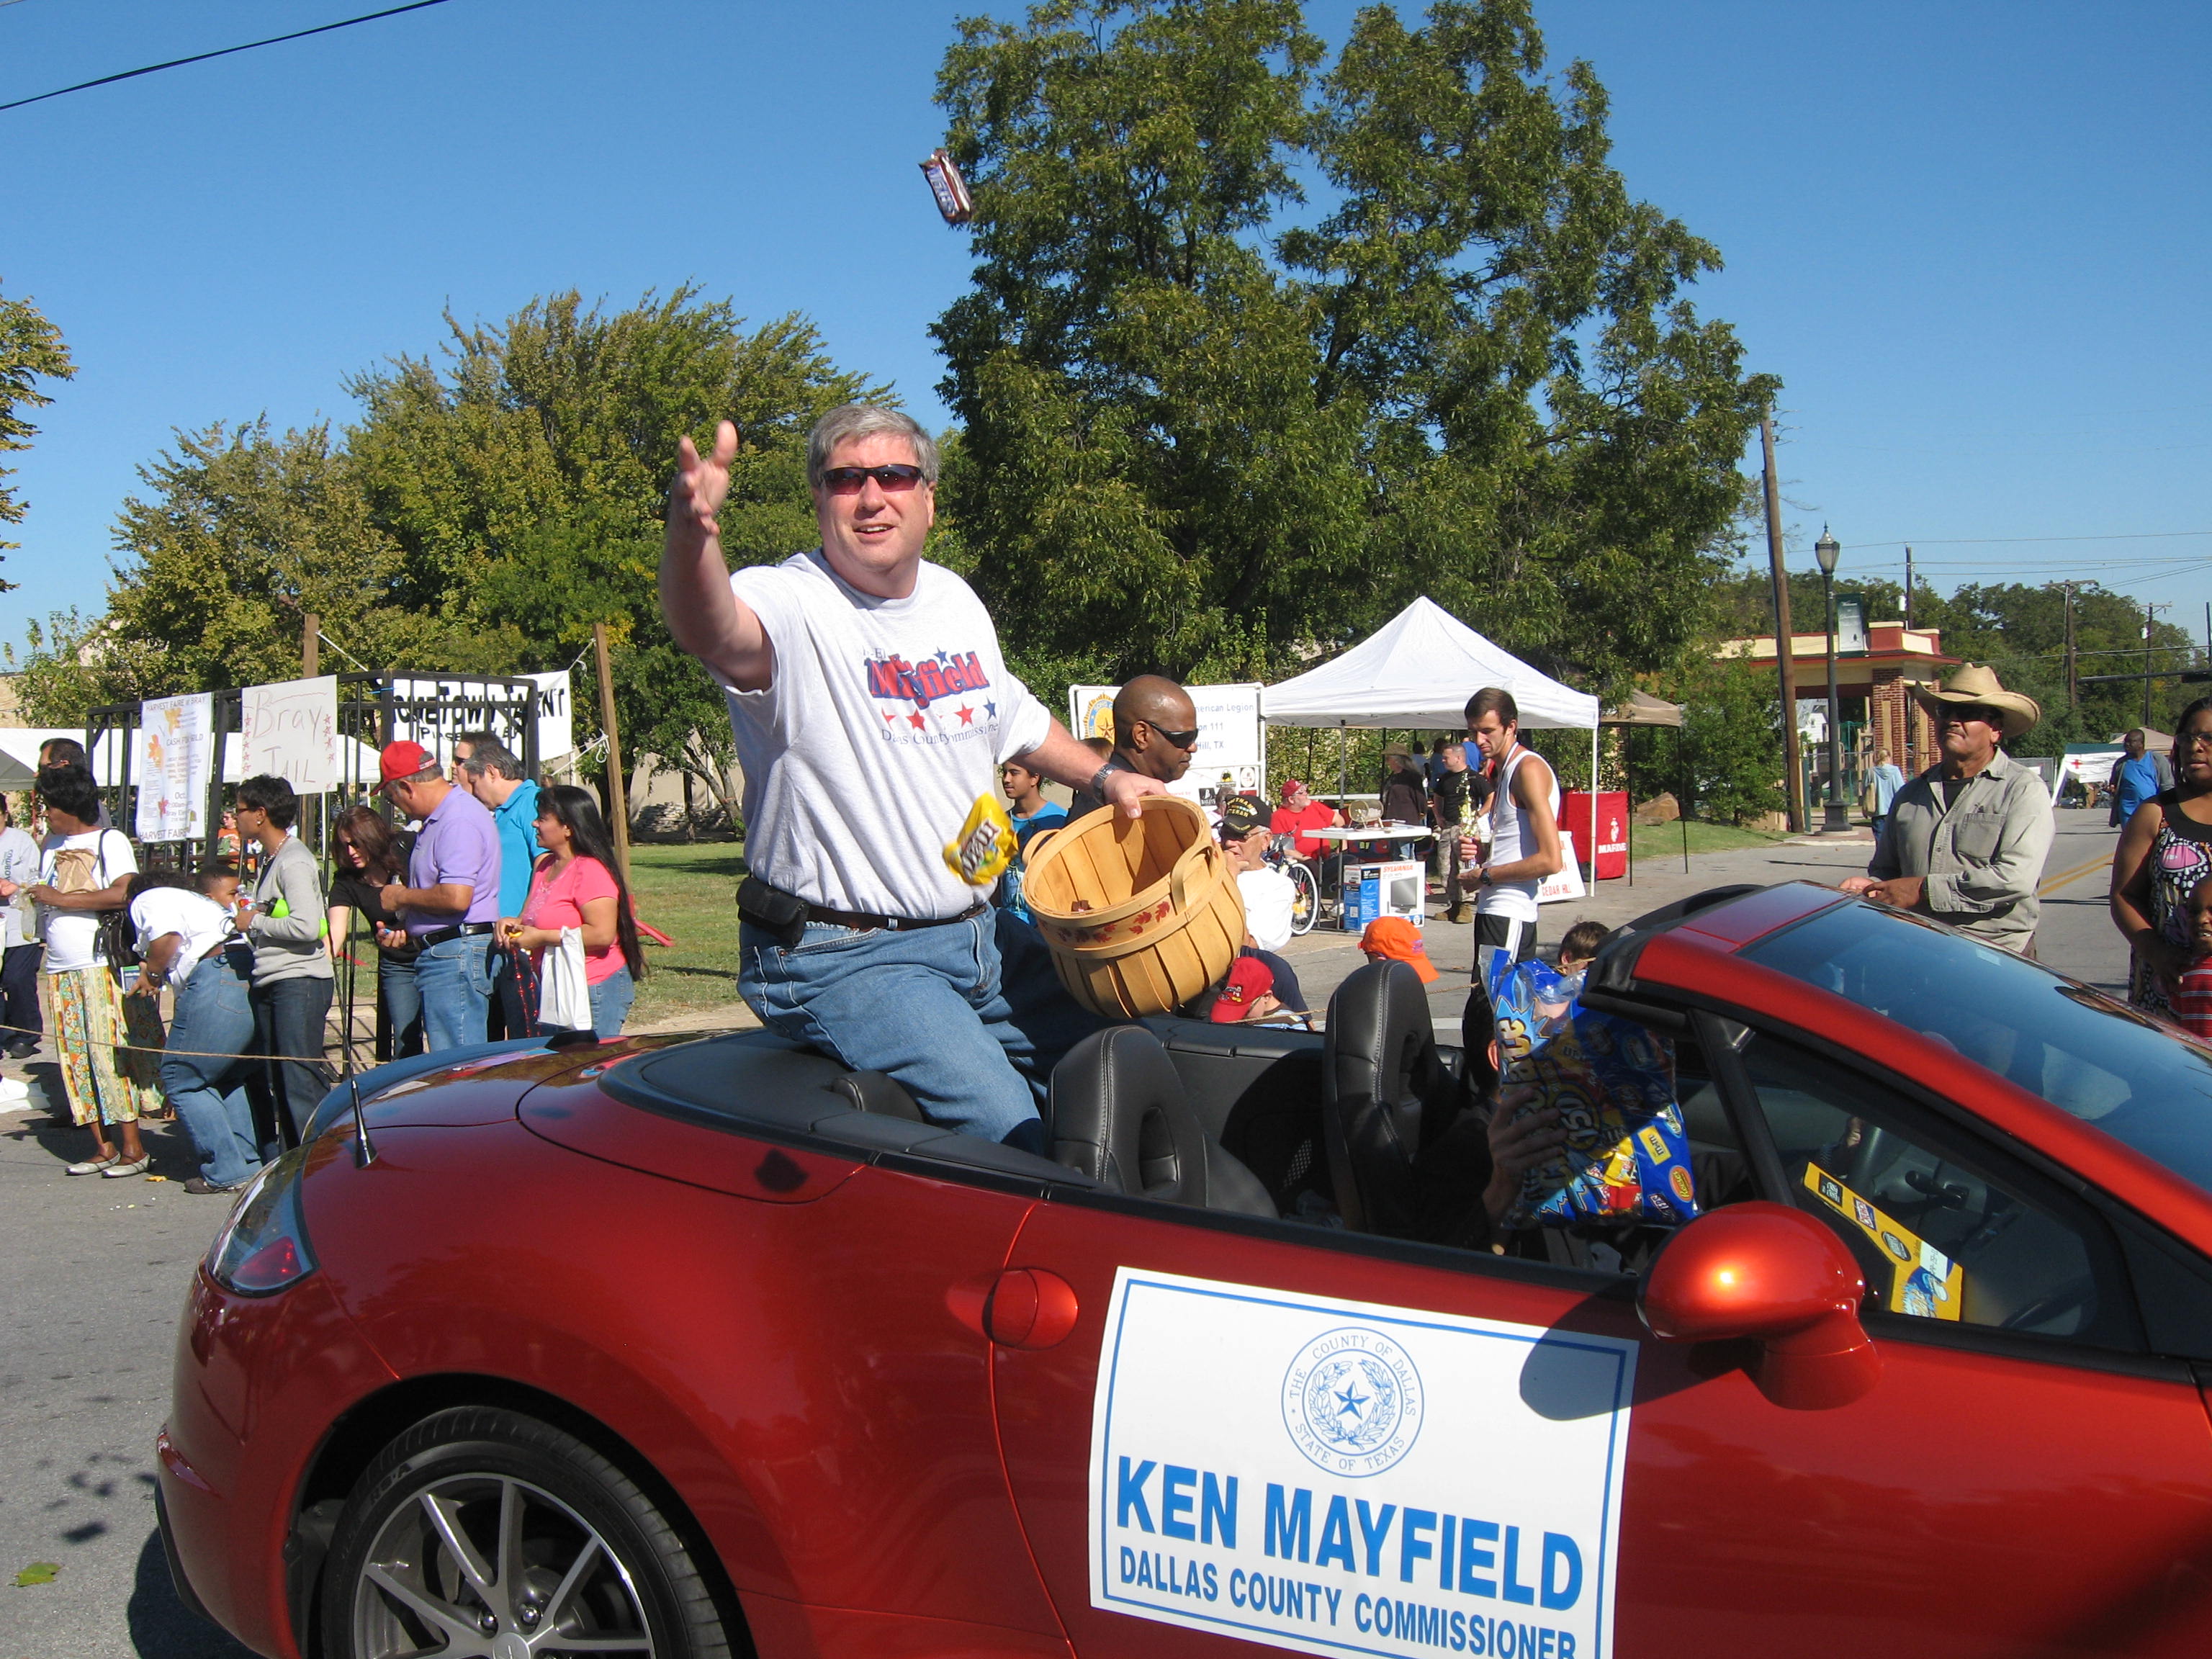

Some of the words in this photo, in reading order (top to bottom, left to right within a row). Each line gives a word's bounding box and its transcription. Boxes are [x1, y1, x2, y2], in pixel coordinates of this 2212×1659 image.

[253, 688, 323, 746] Bray
[1210, 722, 1224, 731] 111
[1226, 703, 1254, 713] Legion
[4, 849, 14, 881] COWBOY
[1383, 864, 1413, 873] SYLVANIA
[1289, 1367, 1307, 1399] THE
[1312, 1335, 1370, 1359] COUNTY
[1375, 1341, 1393, 1357] OF
[1392, 1358, 1416, 1416] DALLAS
[1295, 1422, 1331, 1464] STATE
[1338, 1458, 1357, 1471] OF
[1364, 1436, 1406, 1470] TEXAS
[1118, 1455, 1238, 1549] KEN
[1264, 1483, 1583, 1611] MAYFIELD
[1121, 1546, 1219, 1601] DALLAS
[1231, 1568, 1342, 1625] COUNTY
[1355, 1593, 1576, 1659] COMMISSIONER
